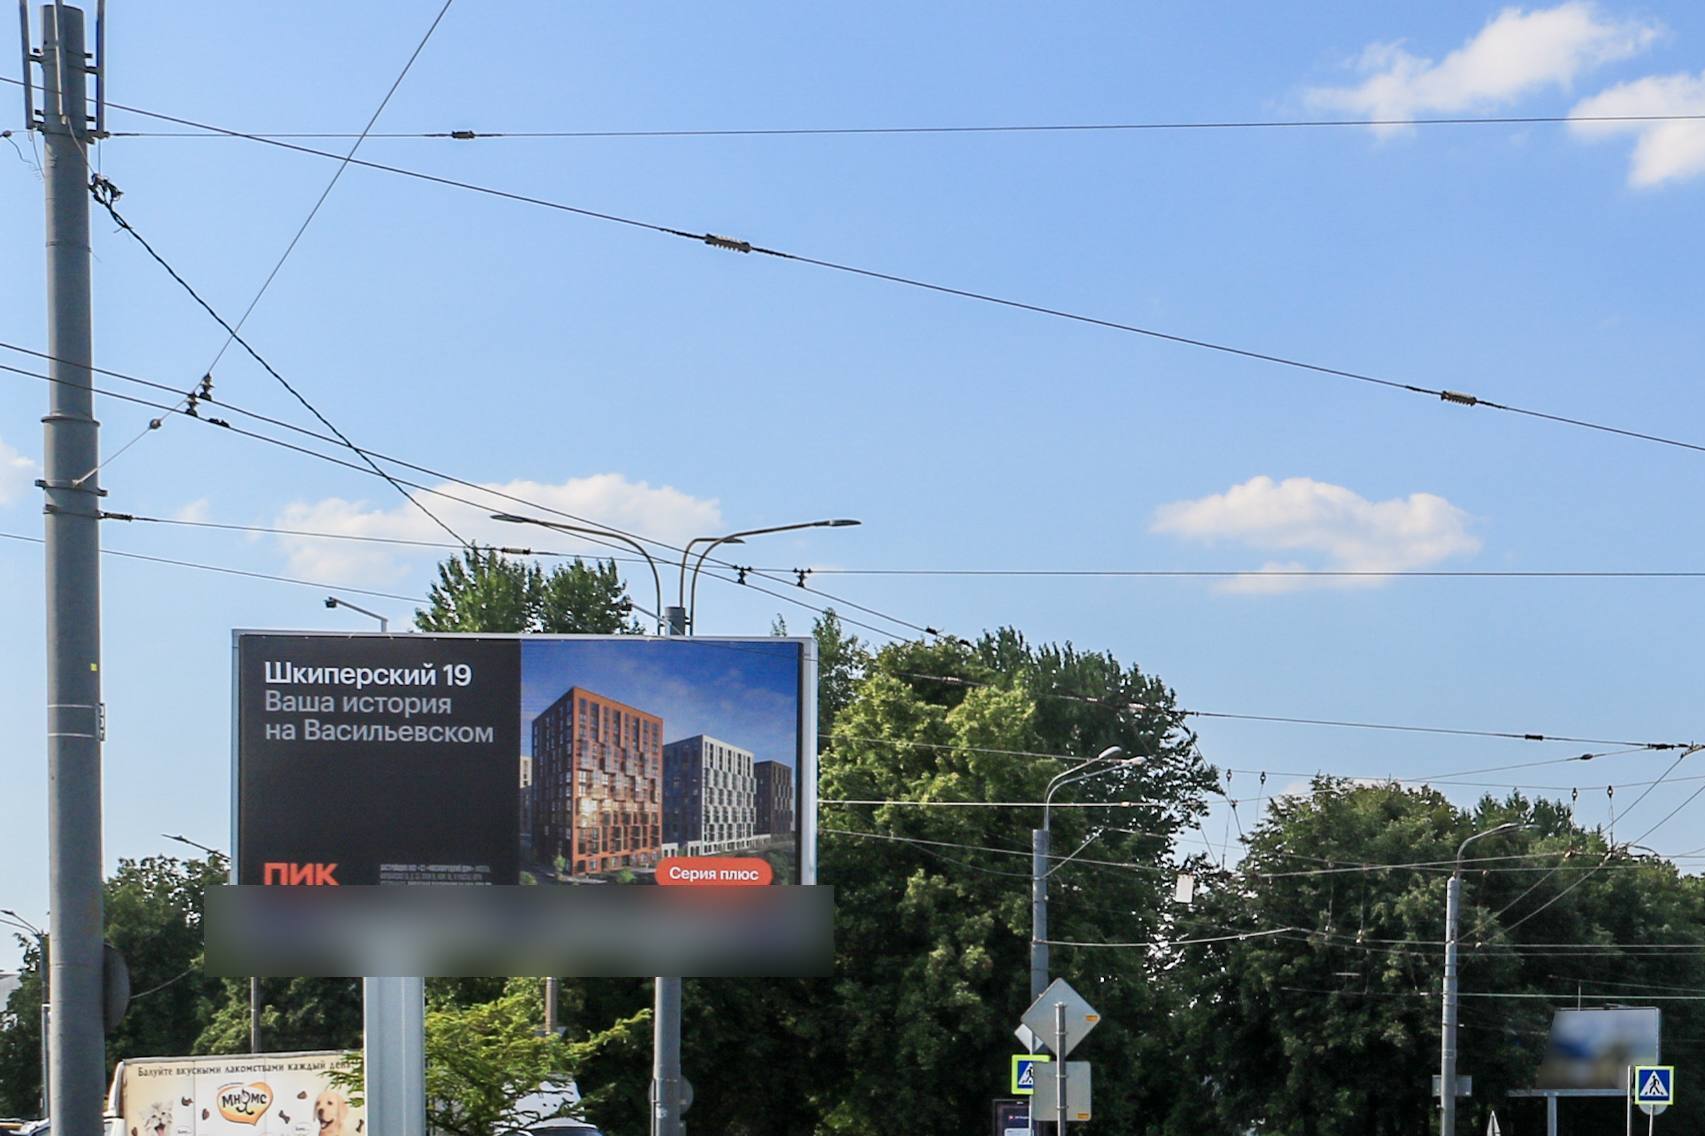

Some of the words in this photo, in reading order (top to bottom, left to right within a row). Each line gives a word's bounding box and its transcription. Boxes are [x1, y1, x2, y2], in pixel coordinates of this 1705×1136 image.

[264, 661, 437, 690] Шкиперский
[442, 663, 473, 687] 19
[264, 689, 335, 713] Ваша
[342, 695, 453, 719] история
[264, 722, 297, 741] на
[303, 718, 494, 744] Васильевском
[263, 862, 340, 886] ПИК
[669, 866, 717, 882] Серия
[719, 869, 759, 881] плюс
[175, 1066, 221, 1076] вкусными
[225, 1063, 285, 1073] лакомствами
[287, 1061, 326, 1071] каждый
